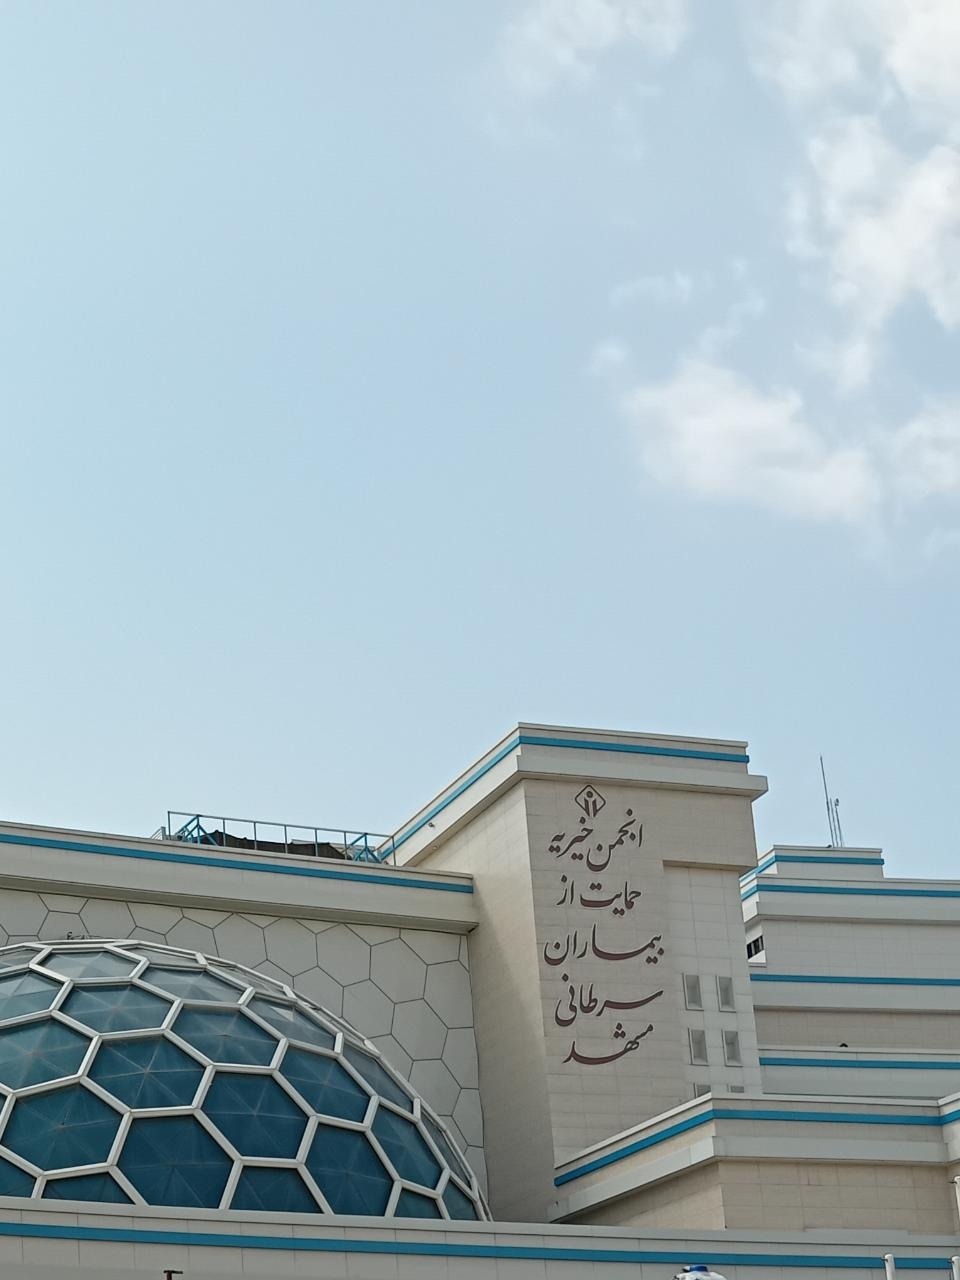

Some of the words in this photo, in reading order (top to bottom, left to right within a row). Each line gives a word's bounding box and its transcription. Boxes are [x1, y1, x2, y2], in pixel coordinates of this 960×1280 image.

[548, 816, 594, 861] خیریه
[586, 808, 643, 872] انجمن
[556, 875, 575, 906] از
[579, 881, 642, 916] حمایت
[543, 923, 664, 966] بیماران
[554, 973, 664, 1027] سرطانی
[562, 1022, 654, 1065] مشهد
